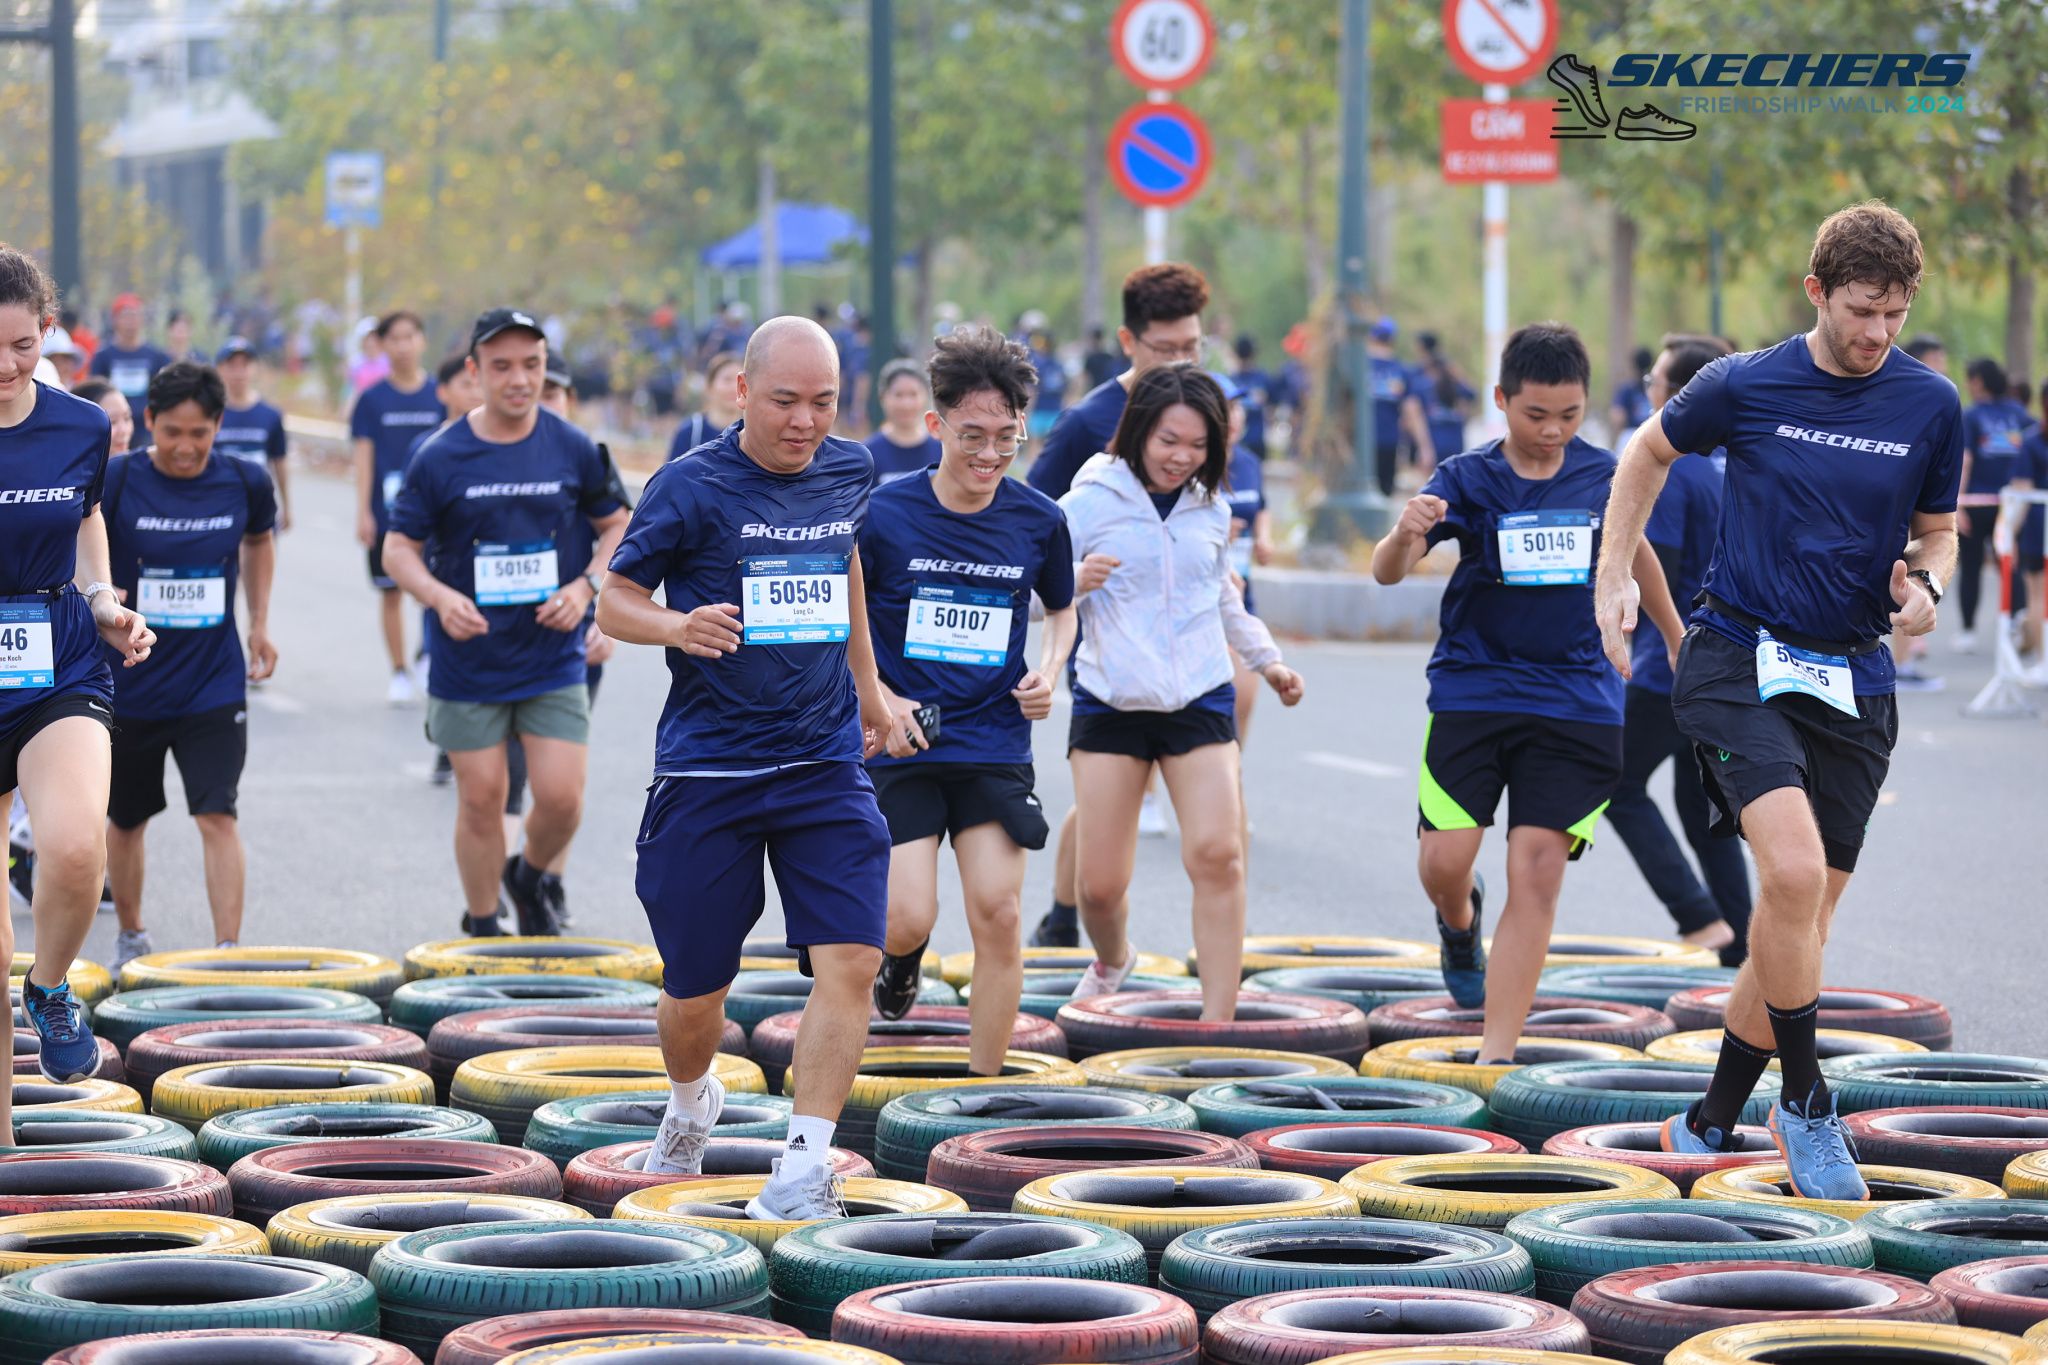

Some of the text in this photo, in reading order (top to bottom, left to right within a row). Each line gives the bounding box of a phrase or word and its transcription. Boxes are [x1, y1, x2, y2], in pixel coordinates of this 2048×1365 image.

[1140, 15, 1186, 63] 60
[1774, 424, 1912, 457] SKECHERS
[0, 486, 76, 504] CHERS
[465, 480, 563, 500] SKECHERS
[136, 515, 234, 532] SKECHERS
[740, 521, 855, 541] SKECHERS
[1523, 531, 1575, 552] 50146
[494, 559, 541, 577] 50162
[907, 558, 1024, 579] SKECHERS
[159, 584, 206, 600] 10558
[769, 579, 832, 605] 50549
[934, 606, 990, 632] 50107
